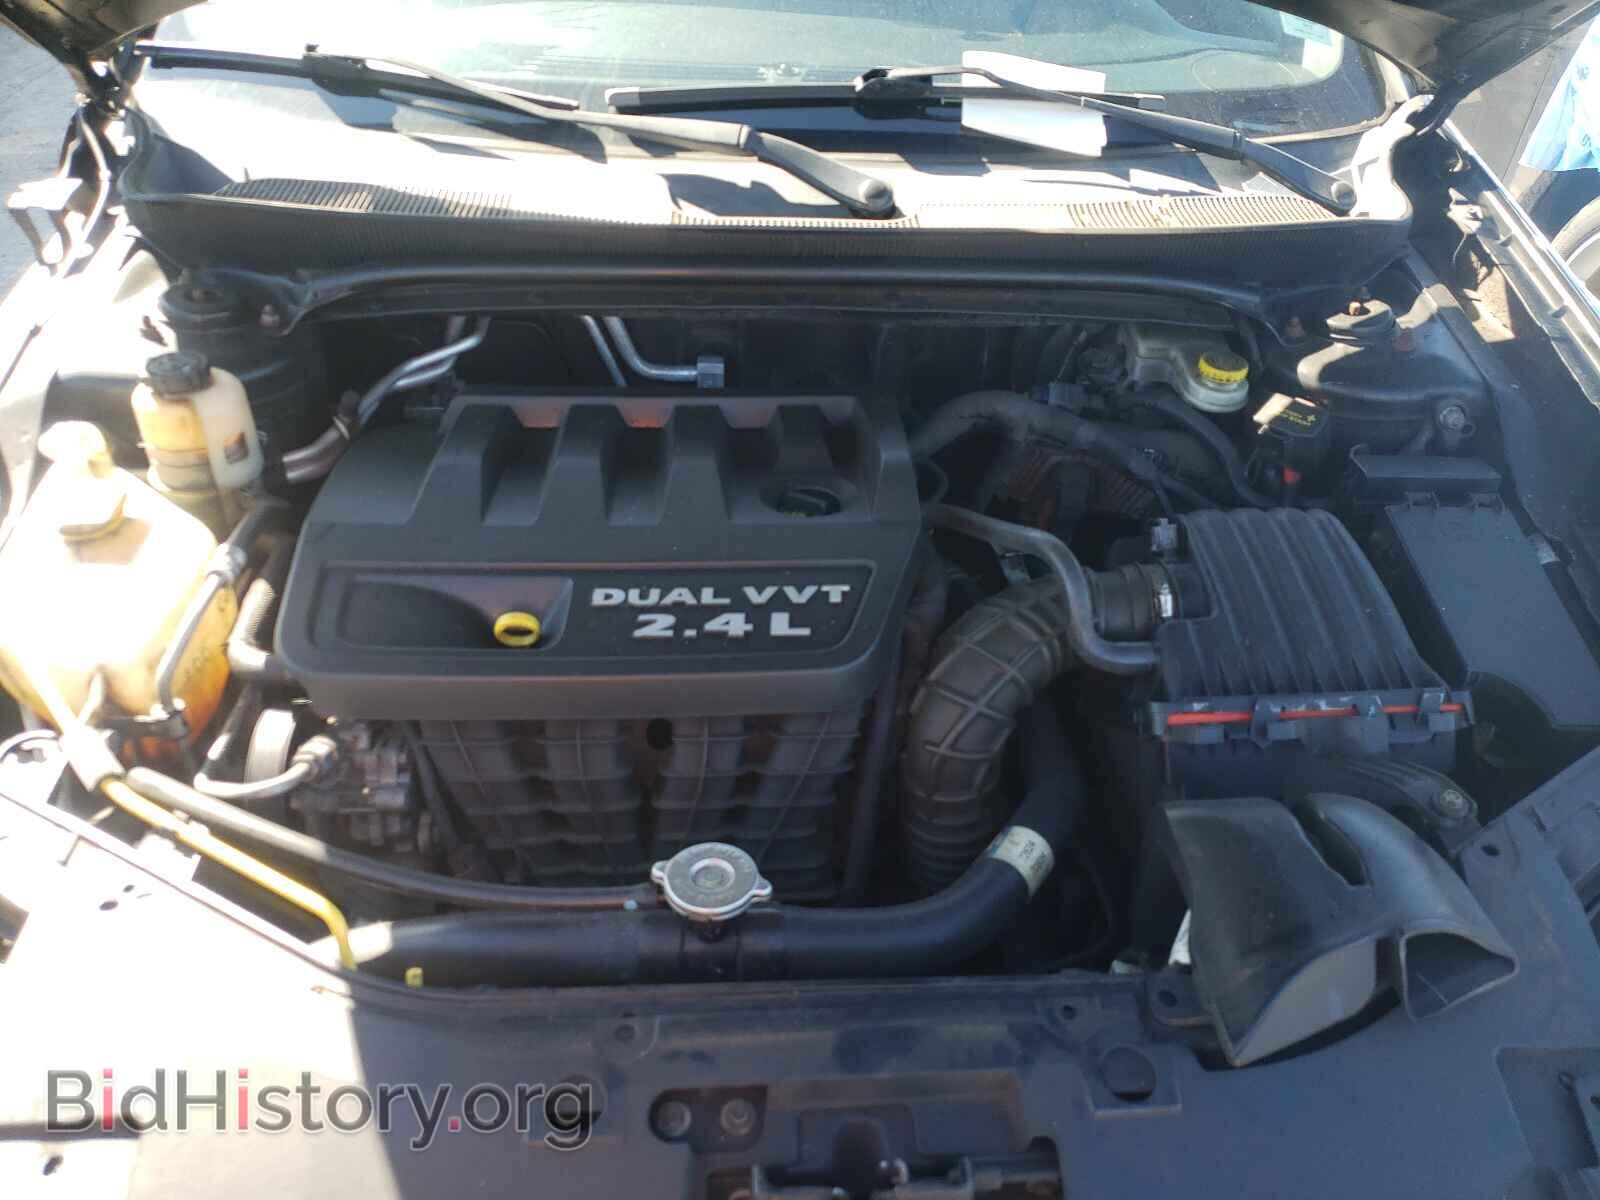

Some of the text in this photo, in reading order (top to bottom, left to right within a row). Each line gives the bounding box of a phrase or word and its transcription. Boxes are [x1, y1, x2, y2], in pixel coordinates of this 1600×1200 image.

[590, 585, 850, 606] DUAL VVT
[632, 611, 811, 637] 2.4 L
